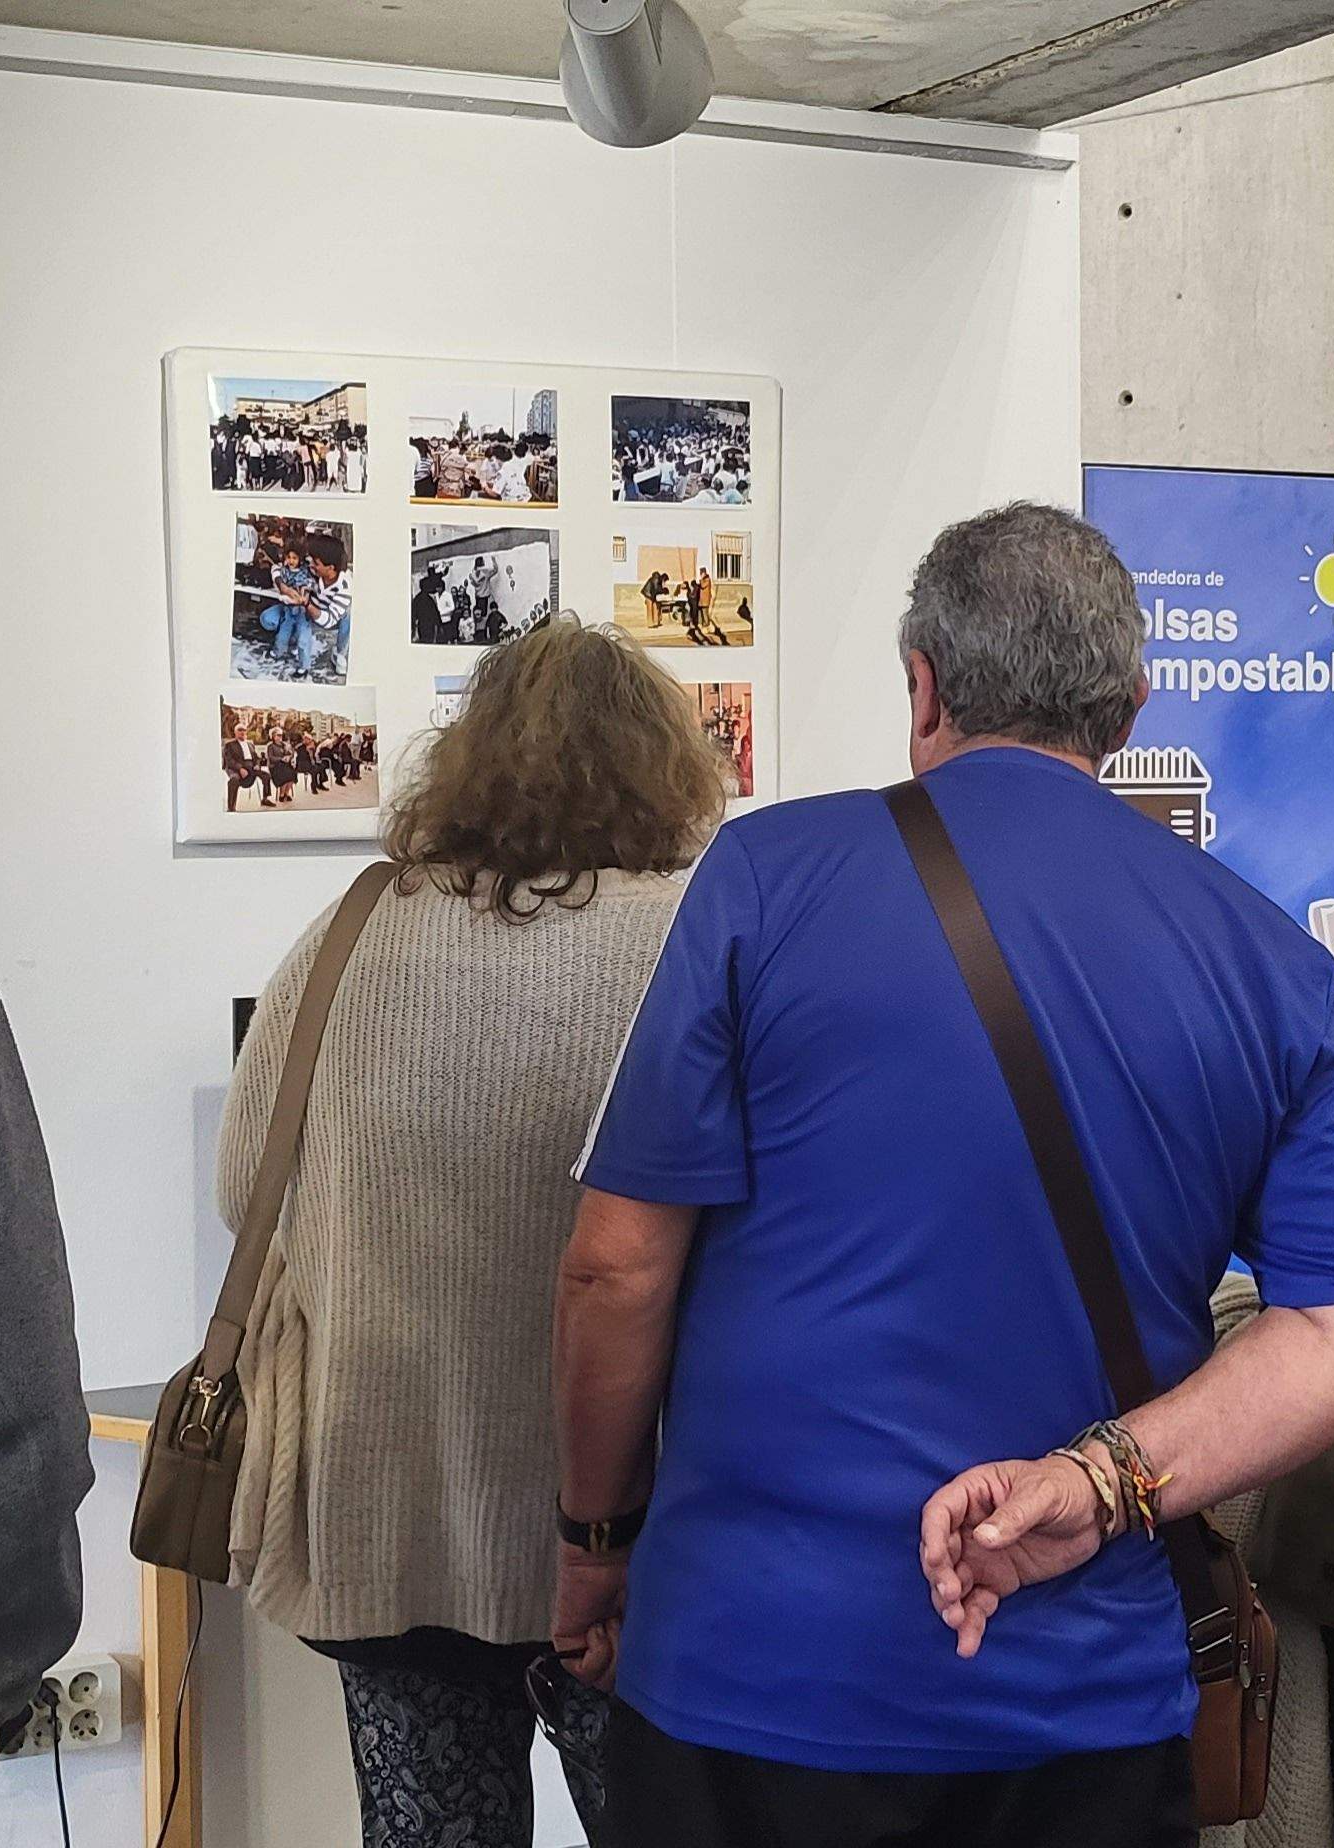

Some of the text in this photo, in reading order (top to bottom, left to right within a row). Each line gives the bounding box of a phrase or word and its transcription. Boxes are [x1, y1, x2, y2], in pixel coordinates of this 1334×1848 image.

[1130, 569, 1224, 587] endedora de
[1140, 598, 1238, 642] lsas
